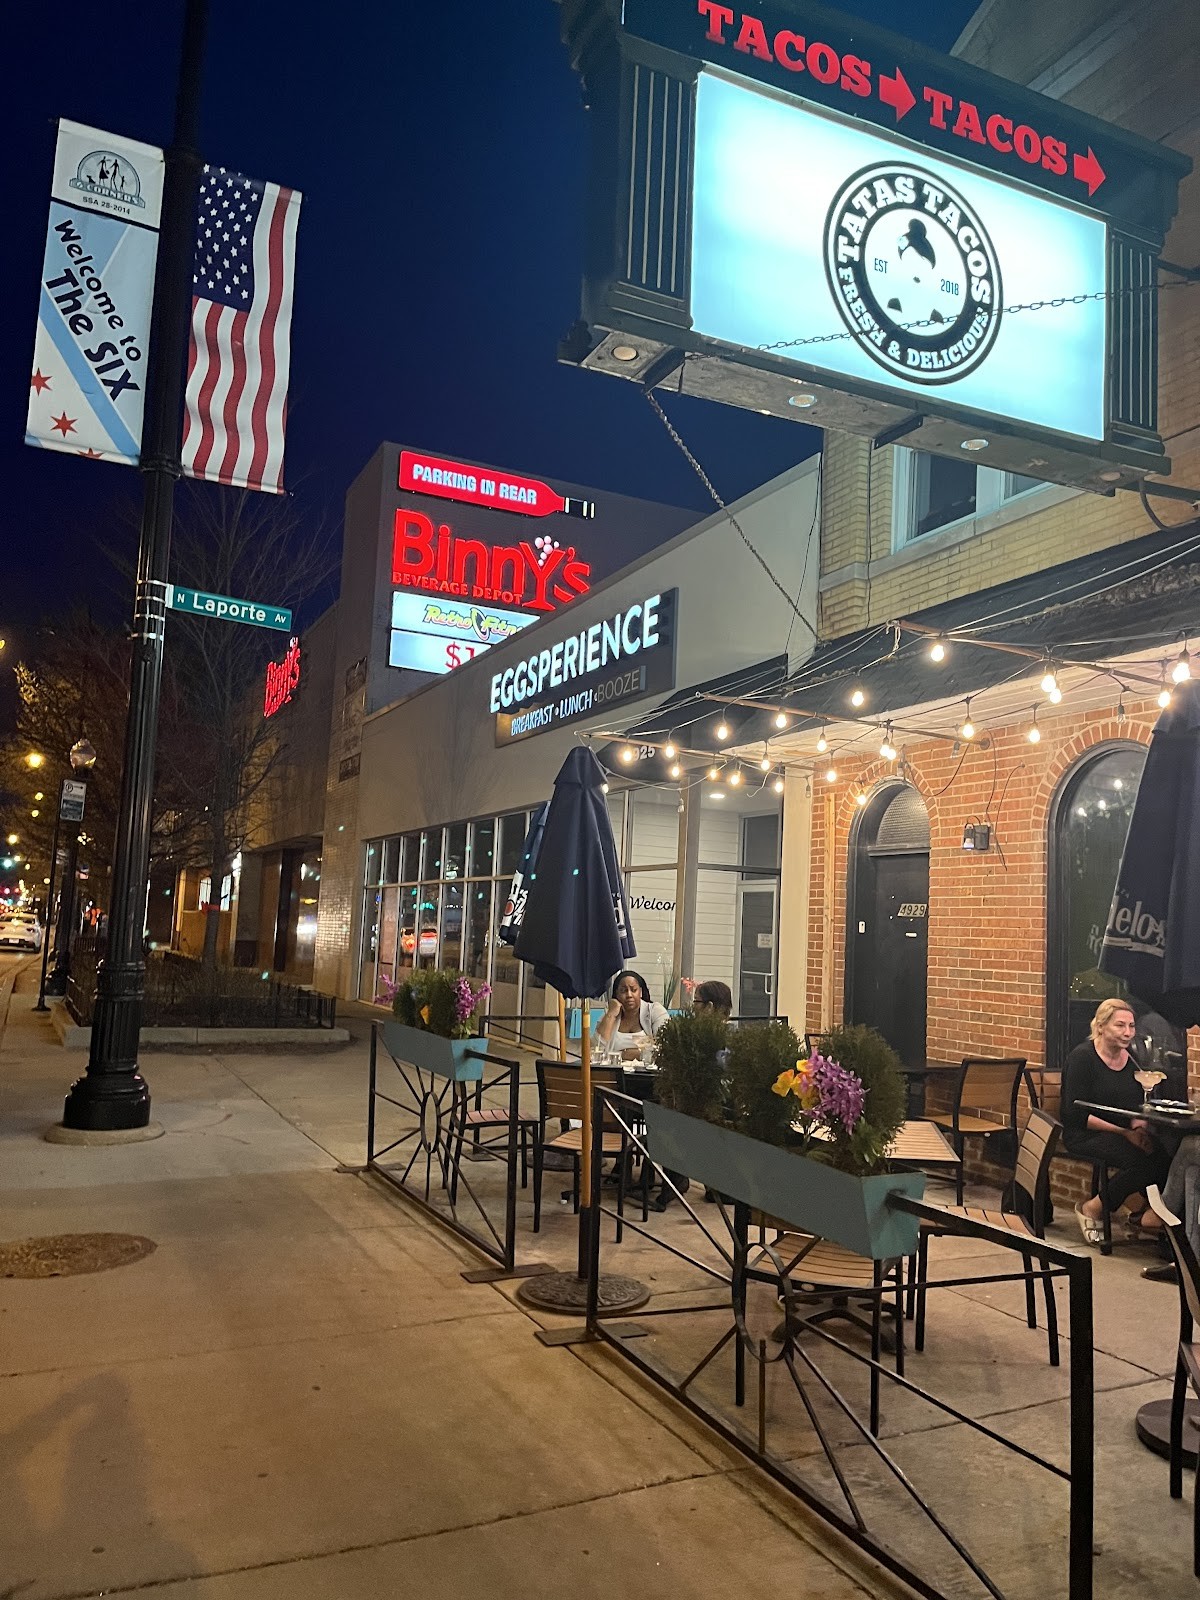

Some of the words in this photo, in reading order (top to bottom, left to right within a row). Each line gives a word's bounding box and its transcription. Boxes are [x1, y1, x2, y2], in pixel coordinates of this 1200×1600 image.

[698, 0, 871, 98] TACOS
[924, 86, 1068, 176] TACOS
[82, 196, 99, 206] SSA
[837, 176, 917, 263] TATAS
[922, 183, 992, 305] TACOS
[874, 258, 888, 274] EST
[45, 267, 94, 336] The
[54, 219, 124, 330] Welcome
[119, 335, 142, 362] to
[940, 278, 960, 296] 2018
[838, 266, 887, 347] FRESH
[887, 341, 901, 360] &
[906, 307, 989, 369] DELICIOUS
[412, 464, 476, 492] PARKING
[480, 478, 495, 496] IN
[499, 483, 537, 505] REAR
[177, 593, 185, 603] N
[193, 592, 266, 622] Laporte
[275, 613, 287, 624] Av
[392, 571, 468, 596] BEVERAGE
[472, 585, 524, 605] DEPOT
[423, 604, 472, 630] Retro
[481, 615, 523, 637] Fitn
[489, 594, 661, 714] EGGSPERIENCE
[511, 704, 554, 737] BREAKFAST
[559, 689, 593, 719] LUNCH
[597, 669, 640, 703] BOOZE
[900, 904, 926, 916] 4929
